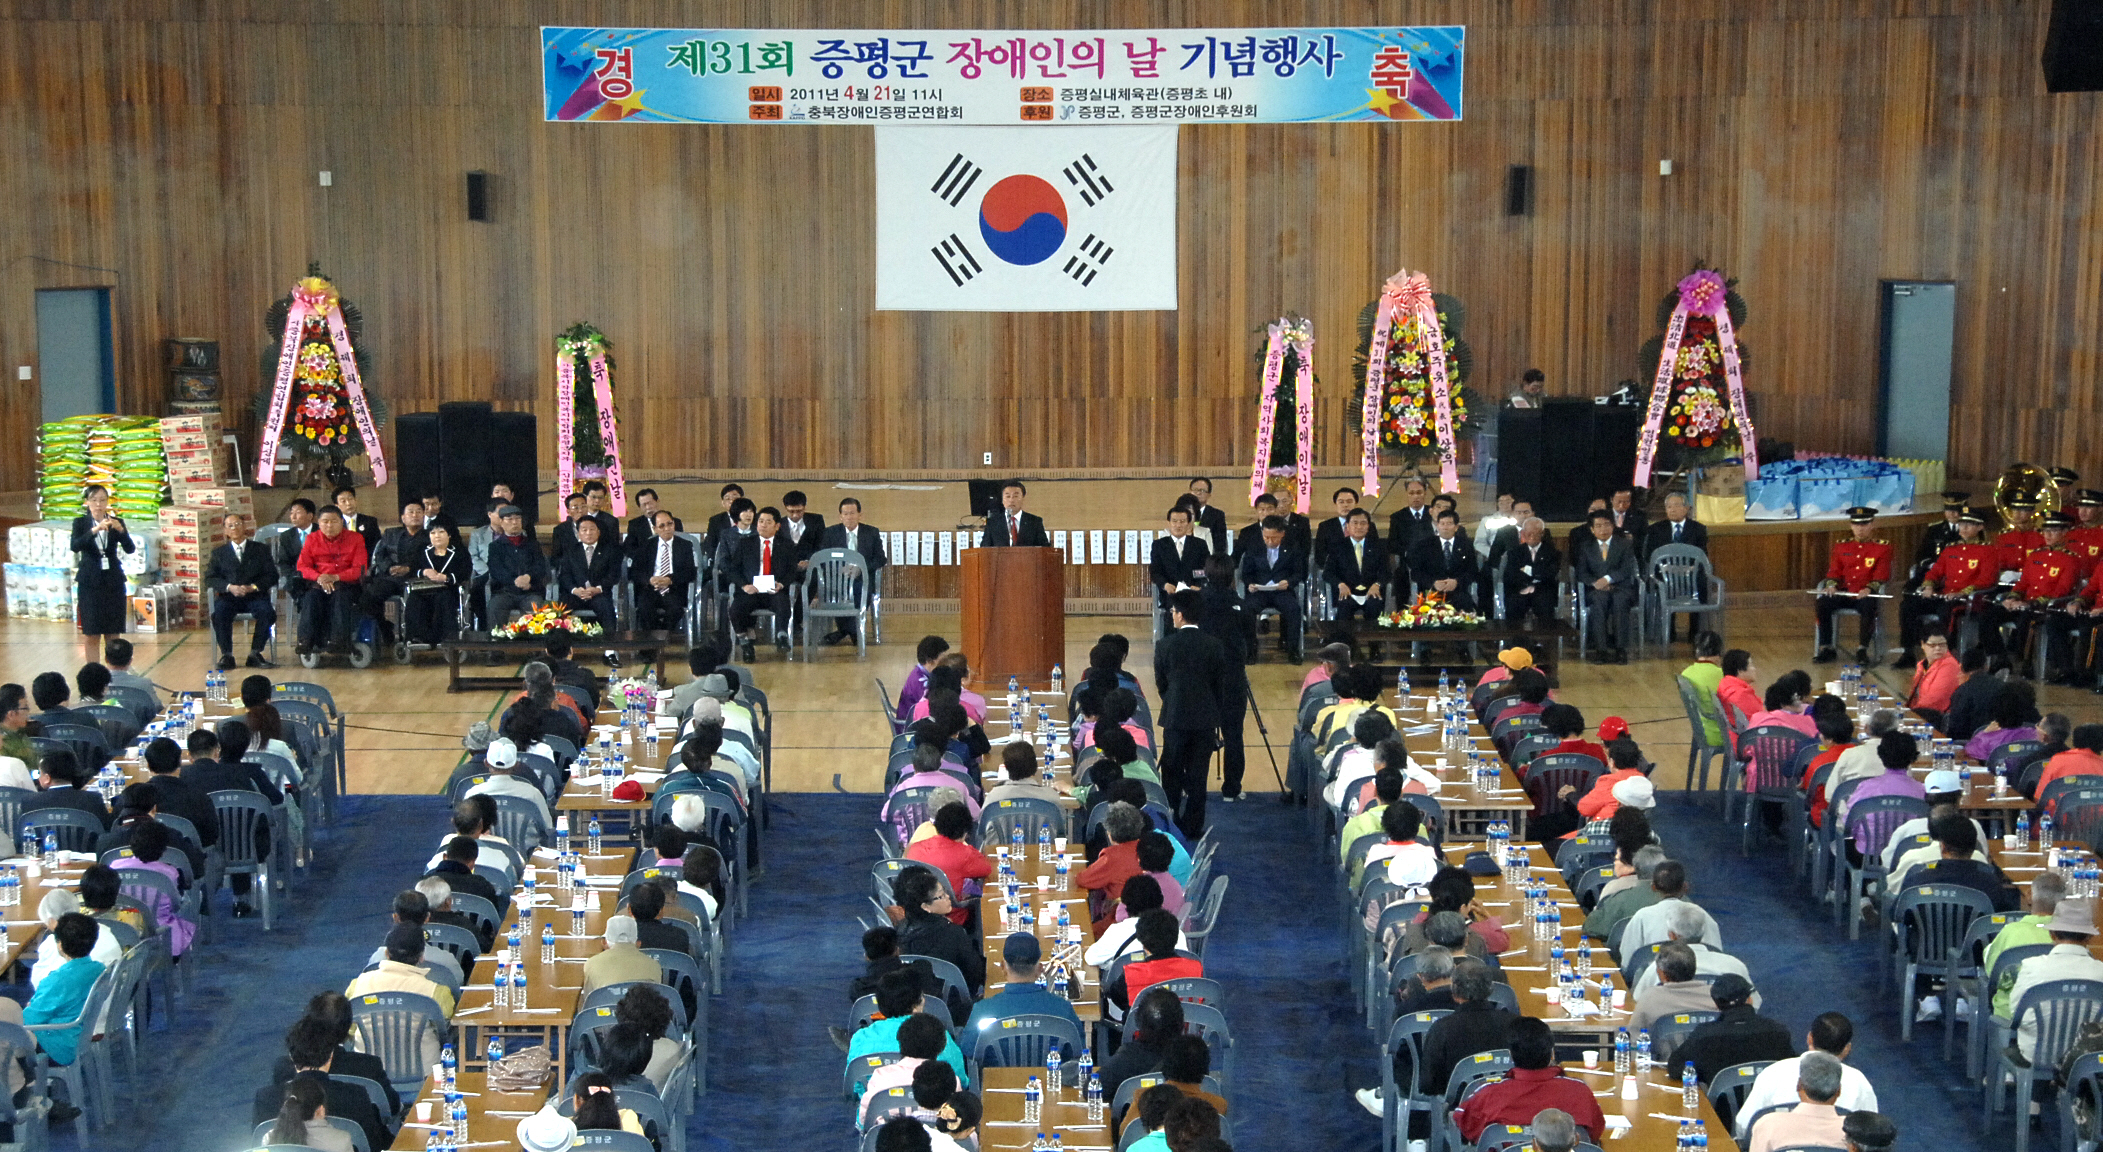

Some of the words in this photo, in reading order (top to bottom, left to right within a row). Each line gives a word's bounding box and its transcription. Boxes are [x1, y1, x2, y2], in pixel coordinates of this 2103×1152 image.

[666, 40, 794, 78] 제31회
[809, 38, 934, 80] 증평군
[945, 37, 1105, 80] 장애인의
[1123, 37, 1167, 80] 날
[1180, 35, 1343, 80] 기념행사
[594, 48, 633, 100] 경
[1369, 45, 1413, 99] 축
[752, 88, 780, 101] 일시
[790, 88, 839, 101] 2011년
[843, 86, 870, 101] 4월
[873, 85, 906, 101] 21일
[912, 88, 943, 101] 11시
[1022, 88, 1051, 101] 장소
[1060, 87, 1209, 101] 증평실내체육관(증평초
[1214, 87, 1233, 101] 내)
[752, 105, 780, 119] 주최
[807, 105, 963, 120] 충북장애인증평군연합회
[1022, 106, 1051, 119] 후원
[1078, 105, 1125, 120] 증평군,
[1131, 105, 1257, 120] 증평군장애인후원회
